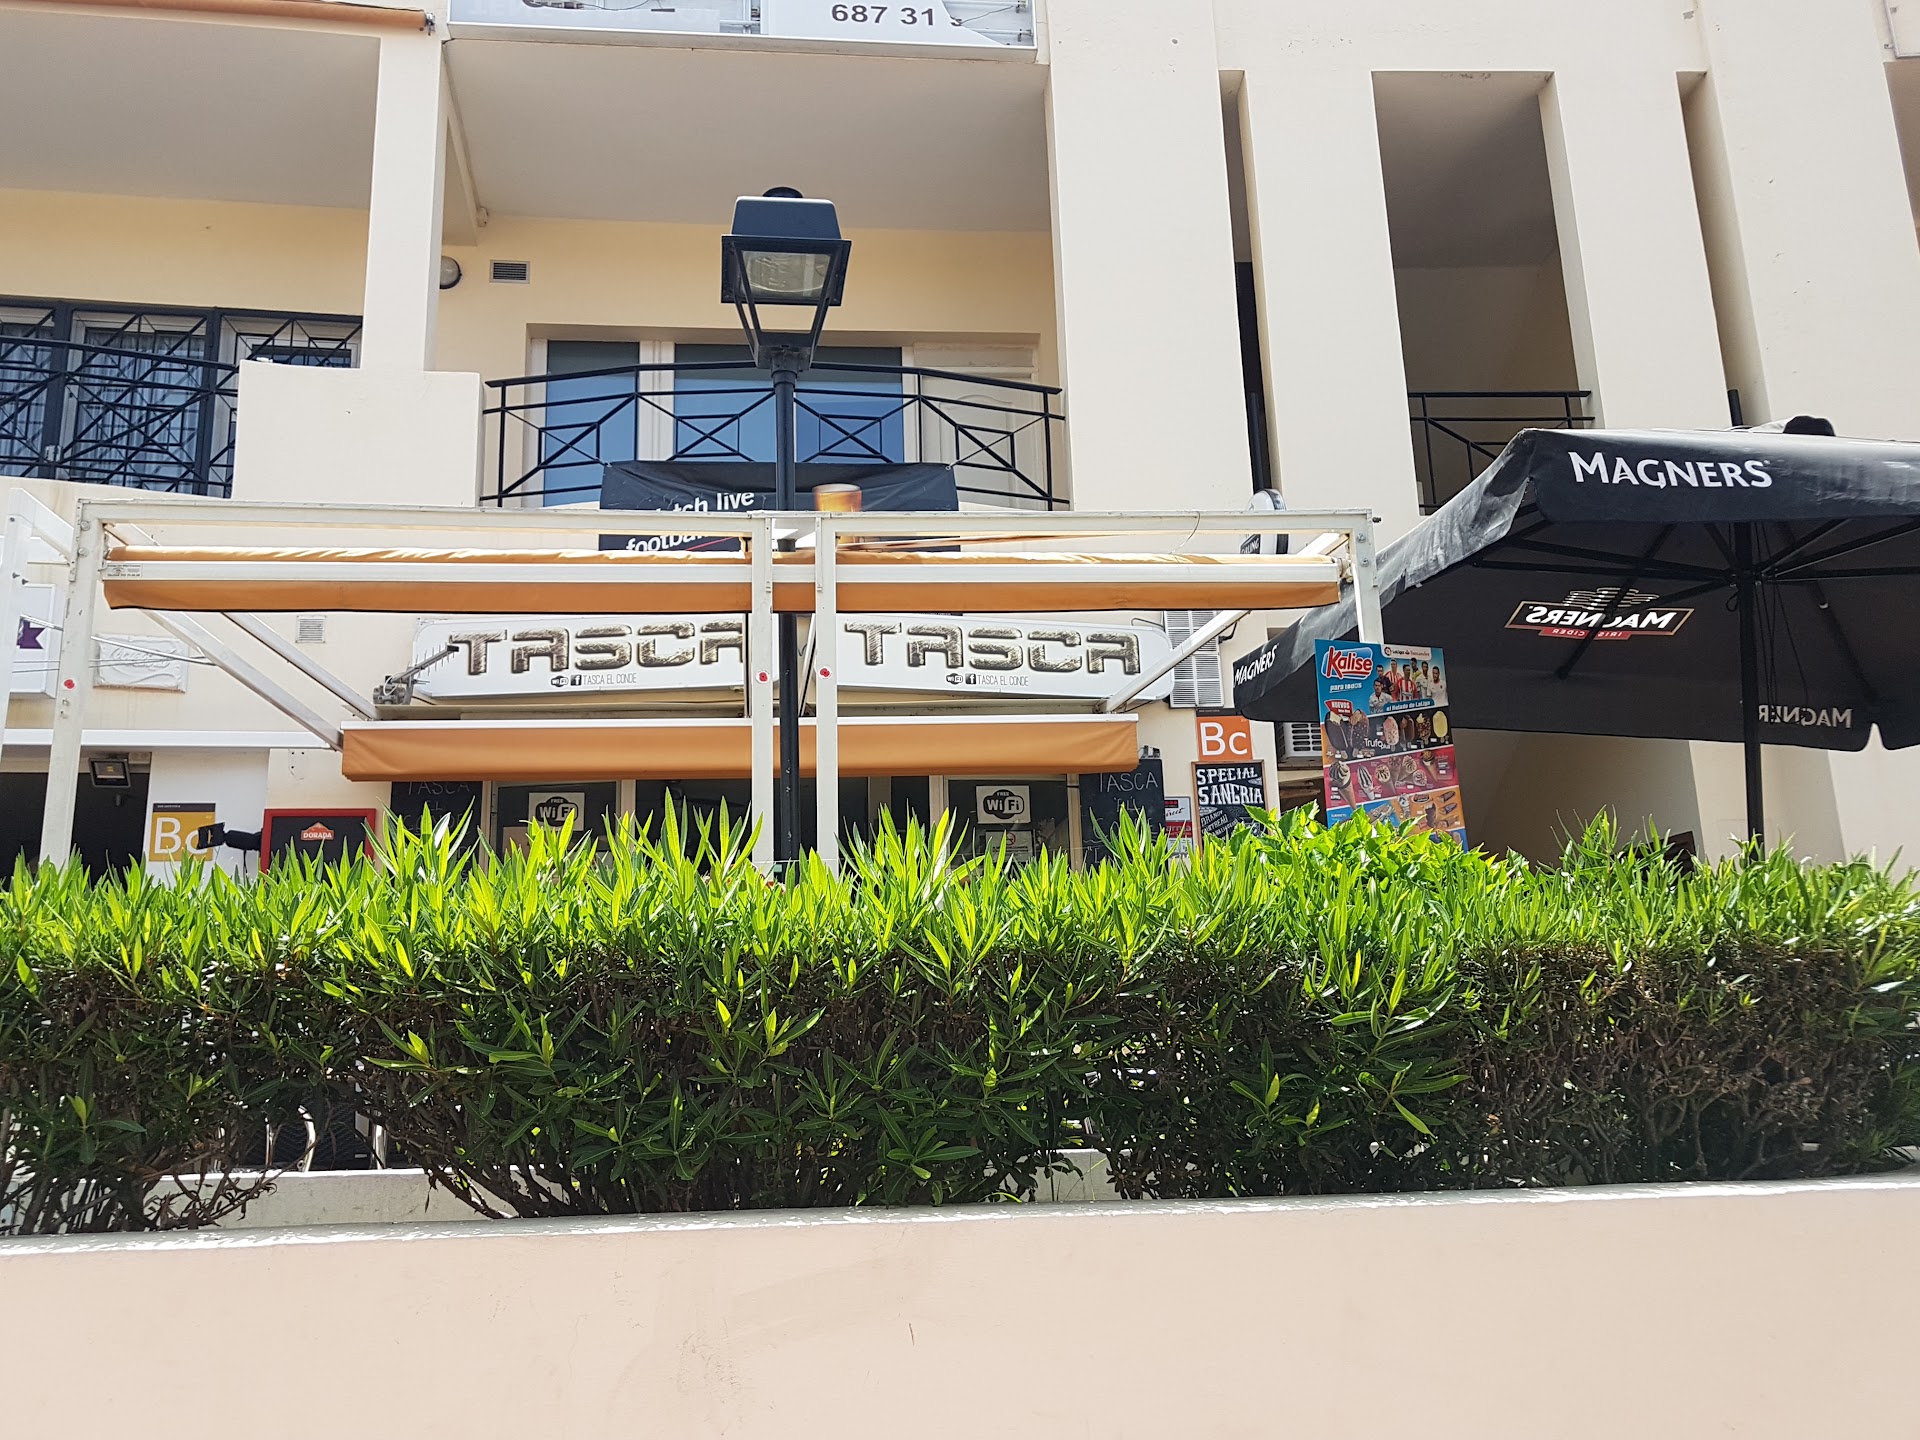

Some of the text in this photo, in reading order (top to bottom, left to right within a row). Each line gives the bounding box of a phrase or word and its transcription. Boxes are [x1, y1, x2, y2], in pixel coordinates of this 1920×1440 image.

[831, 4, 888, 24] 687
[900, 7, 934, 26] 31
[1568, 451, 1773, 489] MAGNERS
[716, 492, 755, 511] live
[845, 619, 1140, 675] TASCA
[1234, 644, 1278, 687] MAGNERS
[1326, 646, 1373, 679] Kalise
[583, 674, 605, 685] TASCA
[607, 673, 614, 684] EL
[978, 674, 998, 685] TASCA
[1000, 675, 1007, 685] EL
[1200, 722, 1248, 756] Bc
[1196, 767, 1258, 786] SPECIAL
[1197, 783, 1264, 805] SANGRIA
